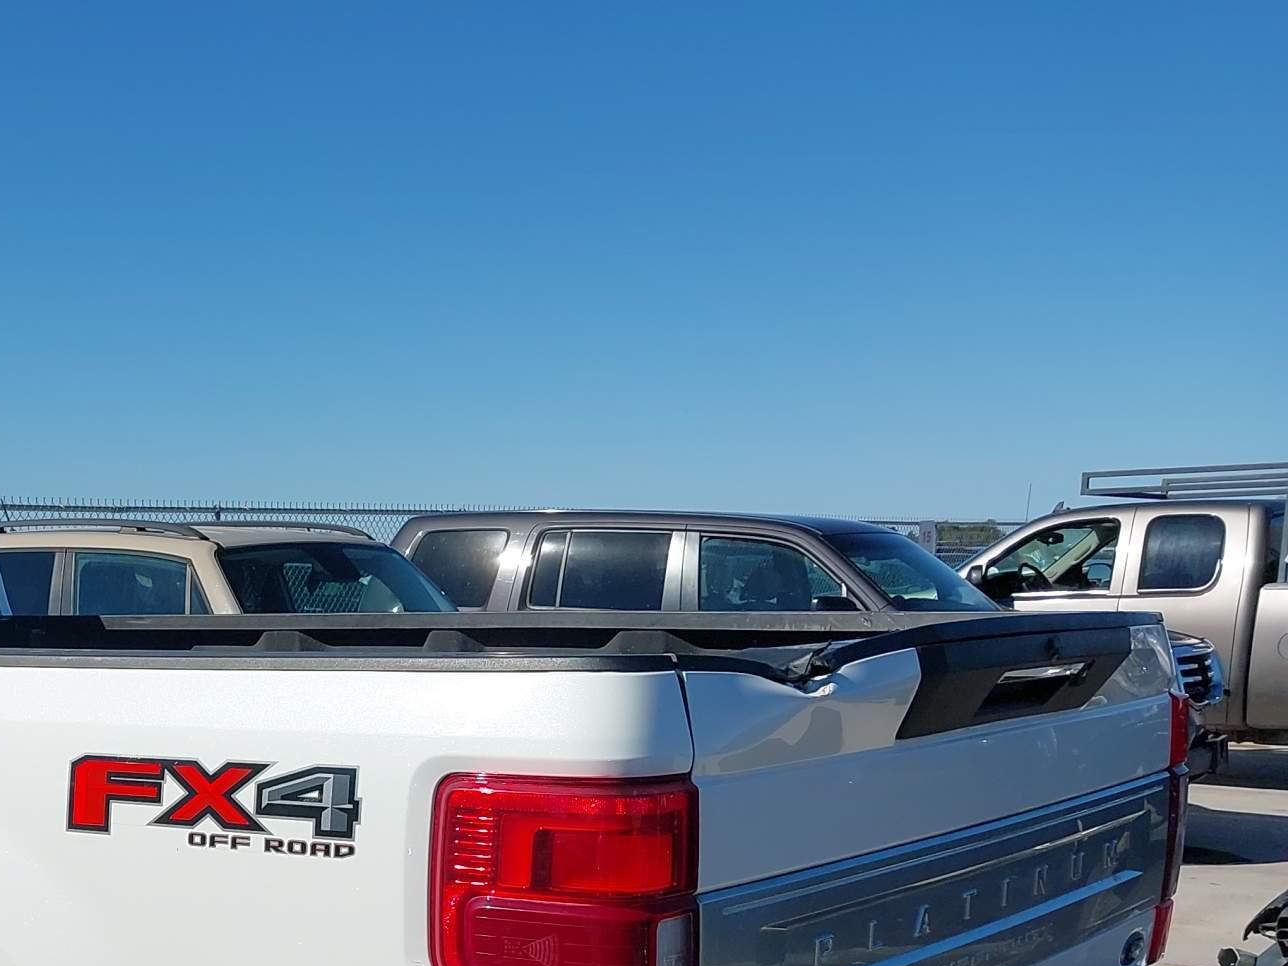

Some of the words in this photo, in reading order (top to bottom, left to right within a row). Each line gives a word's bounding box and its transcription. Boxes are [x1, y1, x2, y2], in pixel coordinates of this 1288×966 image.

[66, 753, 362, 841] FX4
[188, 832, 250, 850] OFF
[264, 838, 355, 858] ROAD
